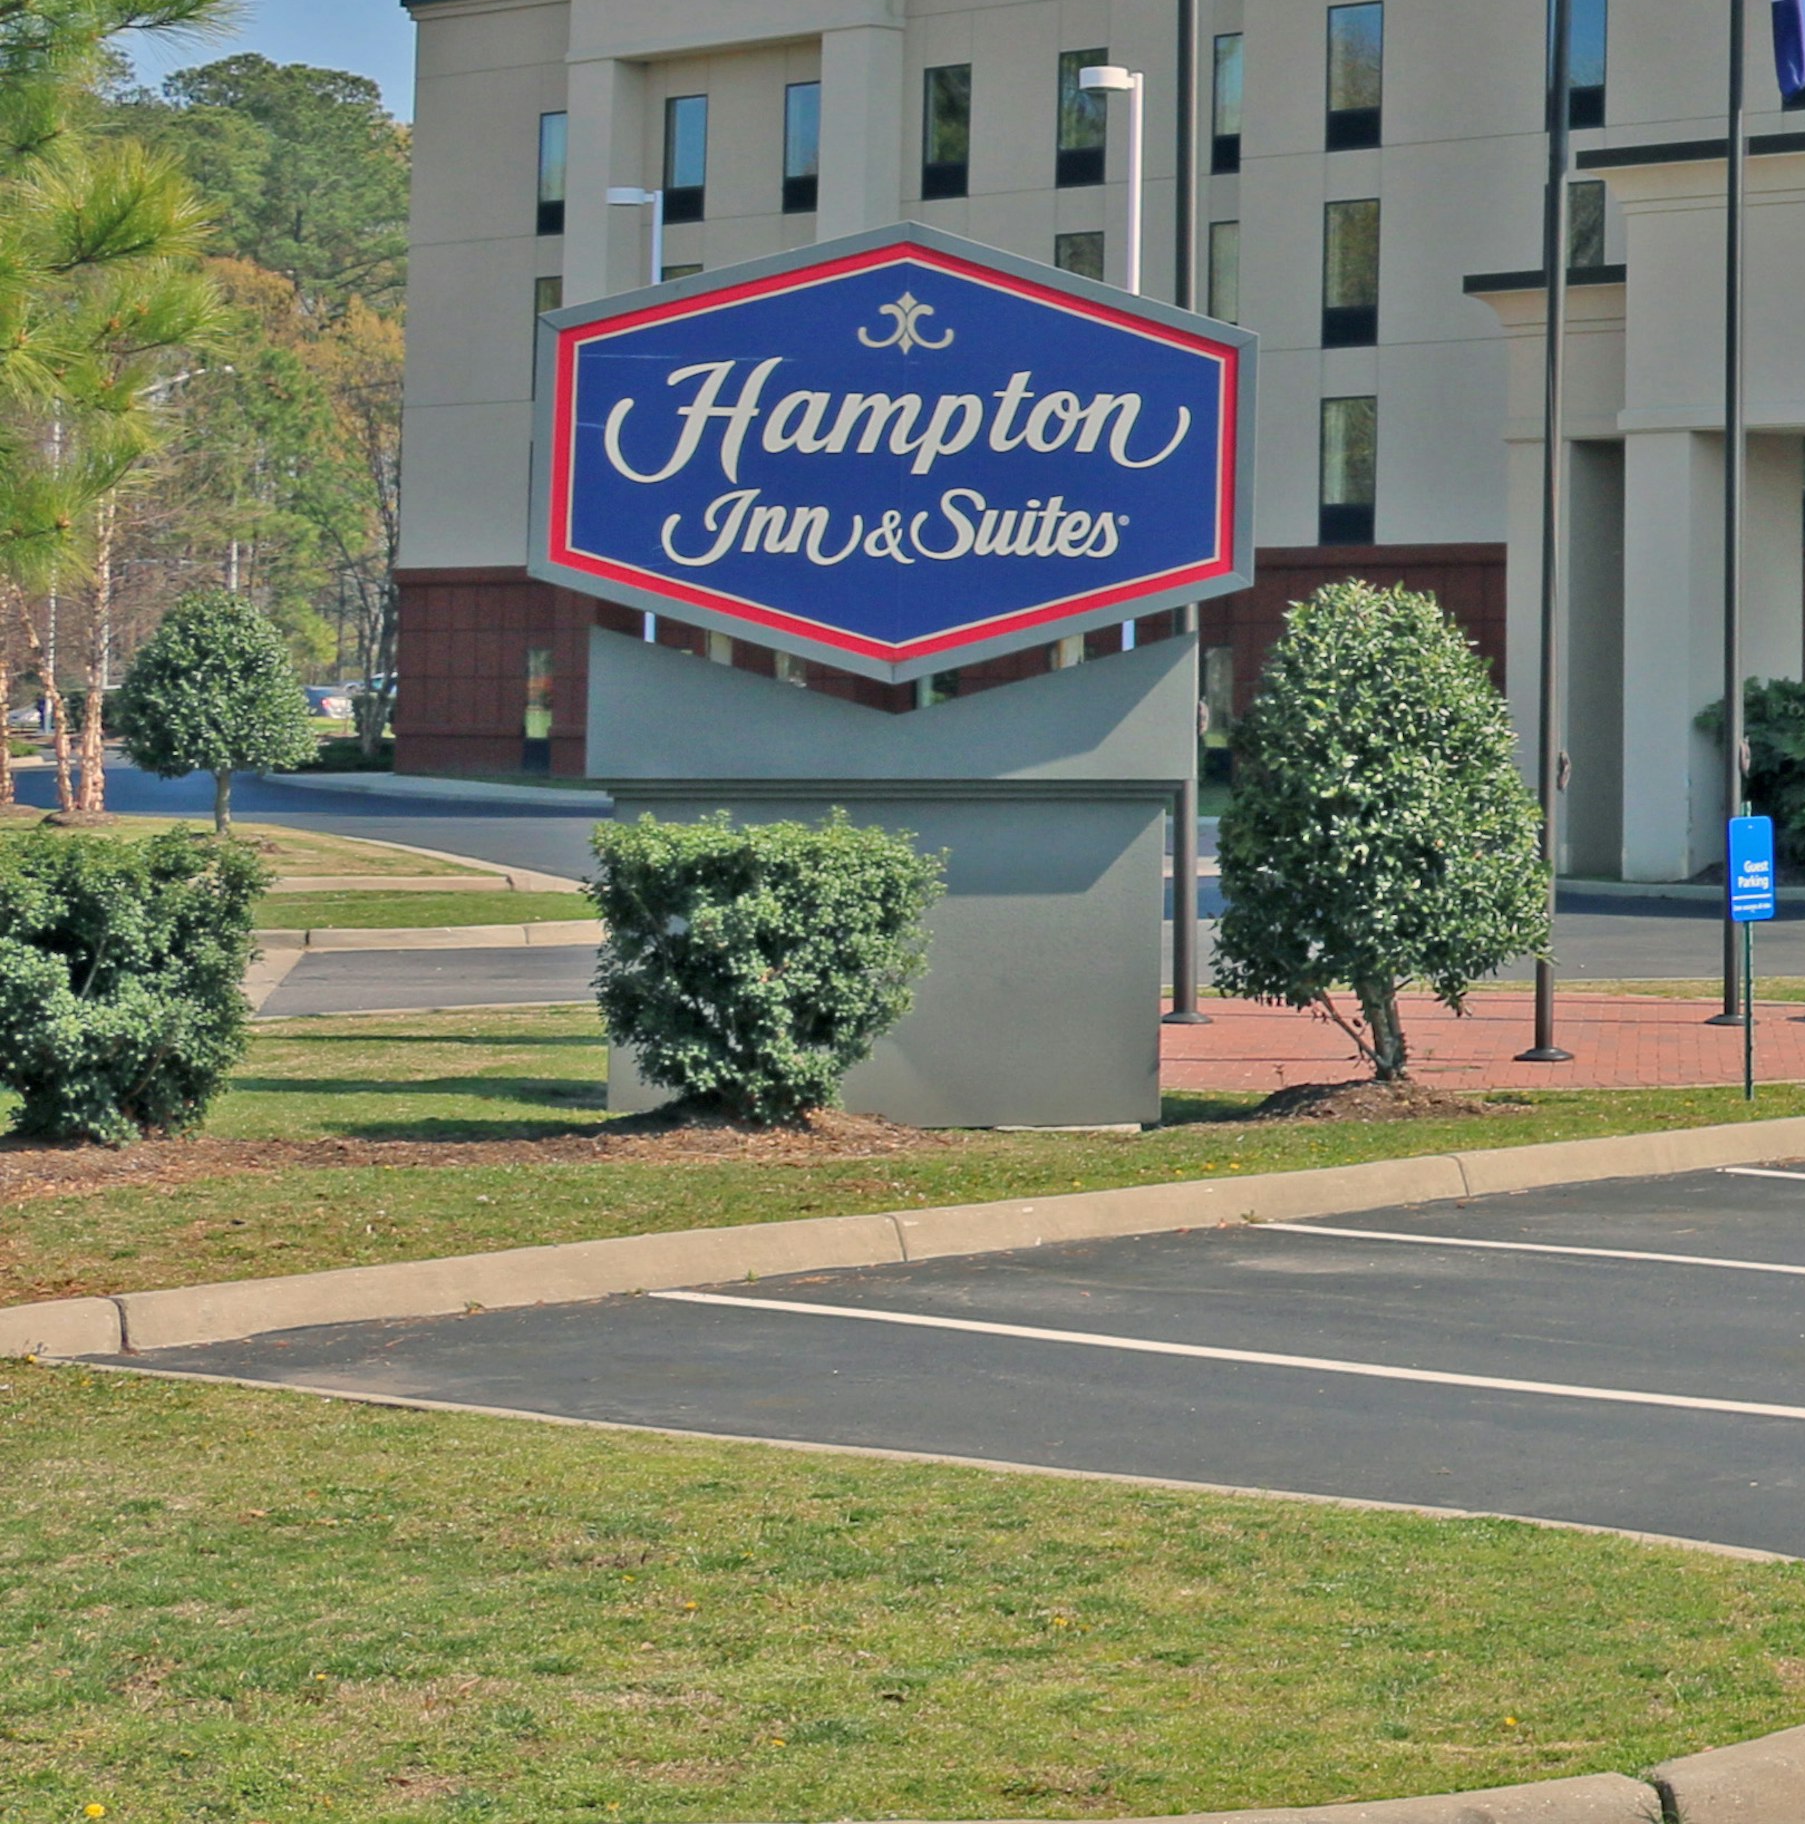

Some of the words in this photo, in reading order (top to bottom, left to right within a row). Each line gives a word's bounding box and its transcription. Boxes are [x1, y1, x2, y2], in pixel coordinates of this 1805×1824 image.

[604, 357, 1191, 484] Hampton
[660, 489, 863, 567] Inn
[863, 509, 915, 565] &
[1737, 874, 1770, 890] Parking
[1743, 860, 1769, 873] Guest
